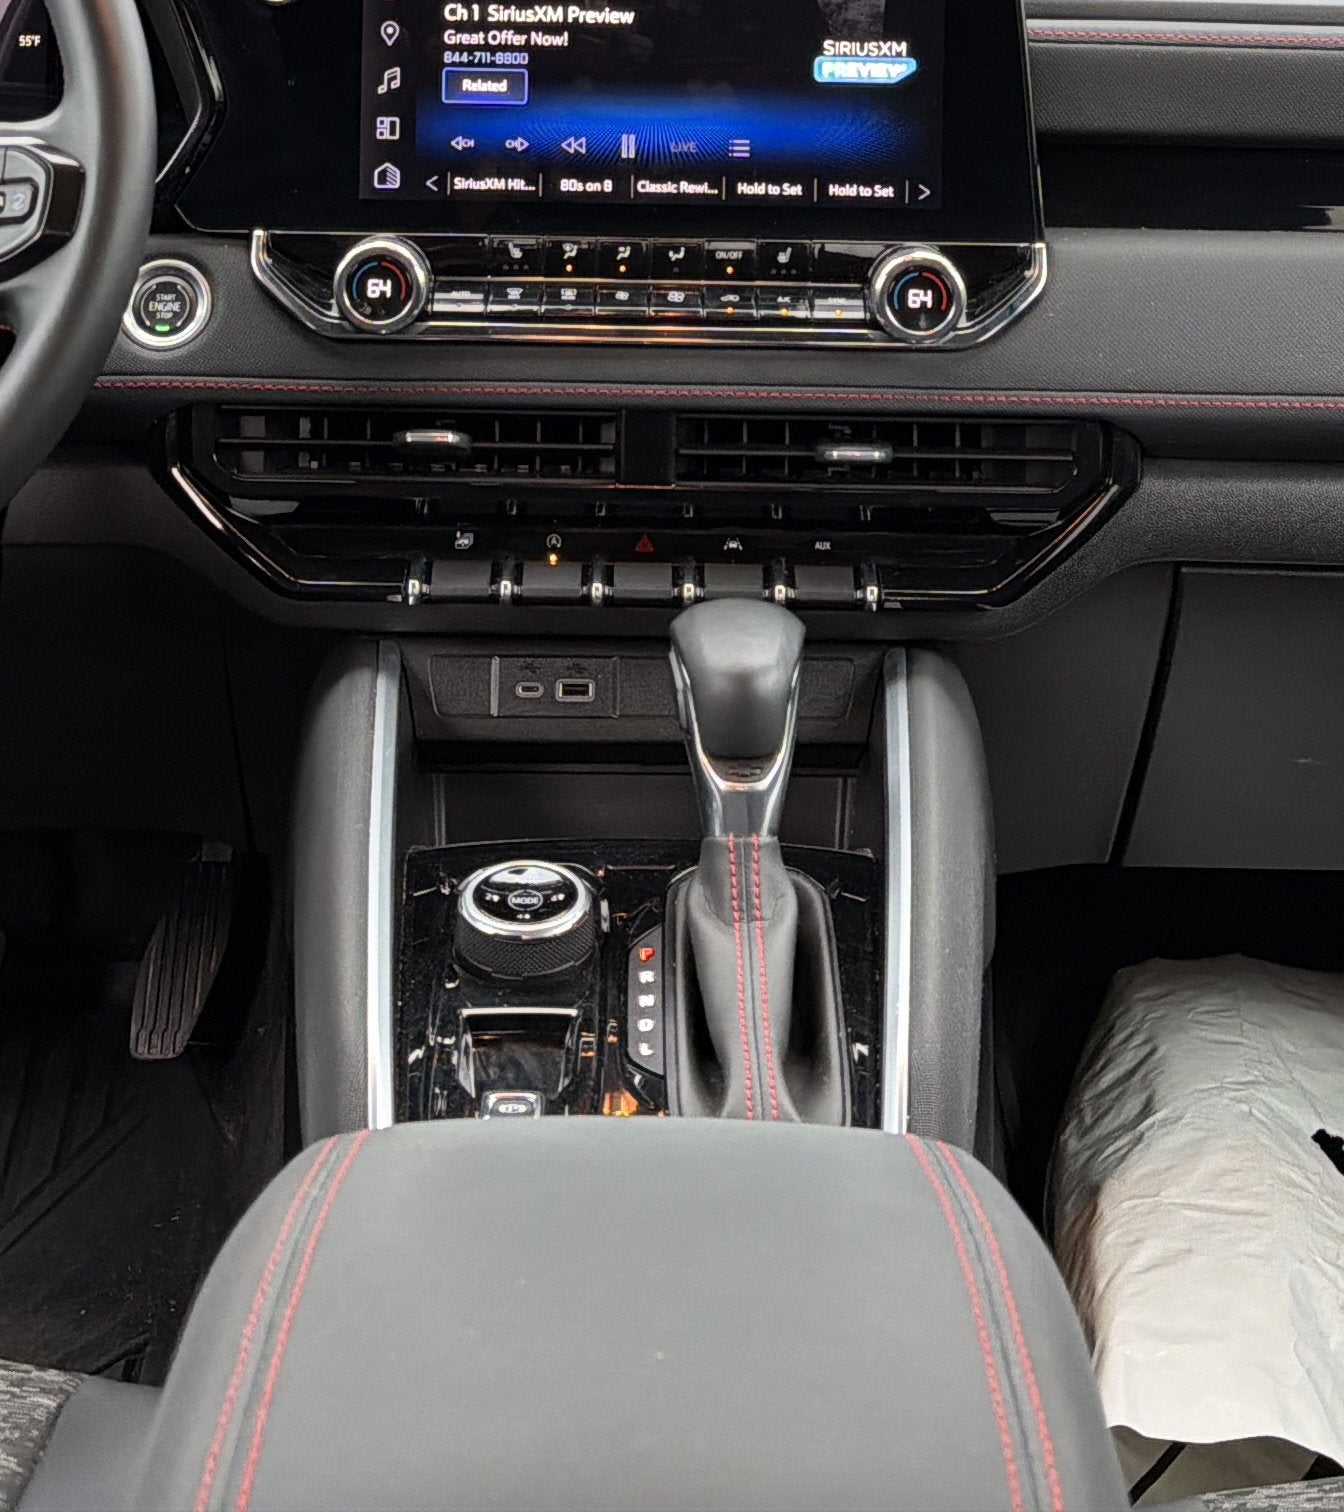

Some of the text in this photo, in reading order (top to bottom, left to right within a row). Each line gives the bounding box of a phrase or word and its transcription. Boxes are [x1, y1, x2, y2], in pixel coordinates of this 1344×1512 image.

[443, 3, 636, 25] Ch 1 SiriusXM Preview
[443, 29, 570, 47] Great Offer Now!
[822, 39, 908, 57] SIRIUSXM
[443, 51, 529, 65] 844-711-8800
[821, 62, 908, 78] PREVIEW
[462, 78, 508, 93] Related
[453, 177, 506, 191] SiriusXM
[559, 179, 613, 192] 80s on 8
[636, 180, 678, 194] Classic
[737, 182, 803, 196] Hold to Set
[828, 184, 895, 198] Hold to Set
[715, 250, 744, 260] ON/OFF
[366, 278, 392, 299] 64
[156, 293, 177, 301] START
[907, 288, 933, 309] 64
[148, 301, 182, 312] ENGINE
[815, 540, 832, 551] AUX
[511, 896, 539, 905] MODE
[639, 947, 655, 963] P
[639, 970, 655, 984] R
[639, 994, 655, 1007] N
[638, 1018, 655, 1032] D
